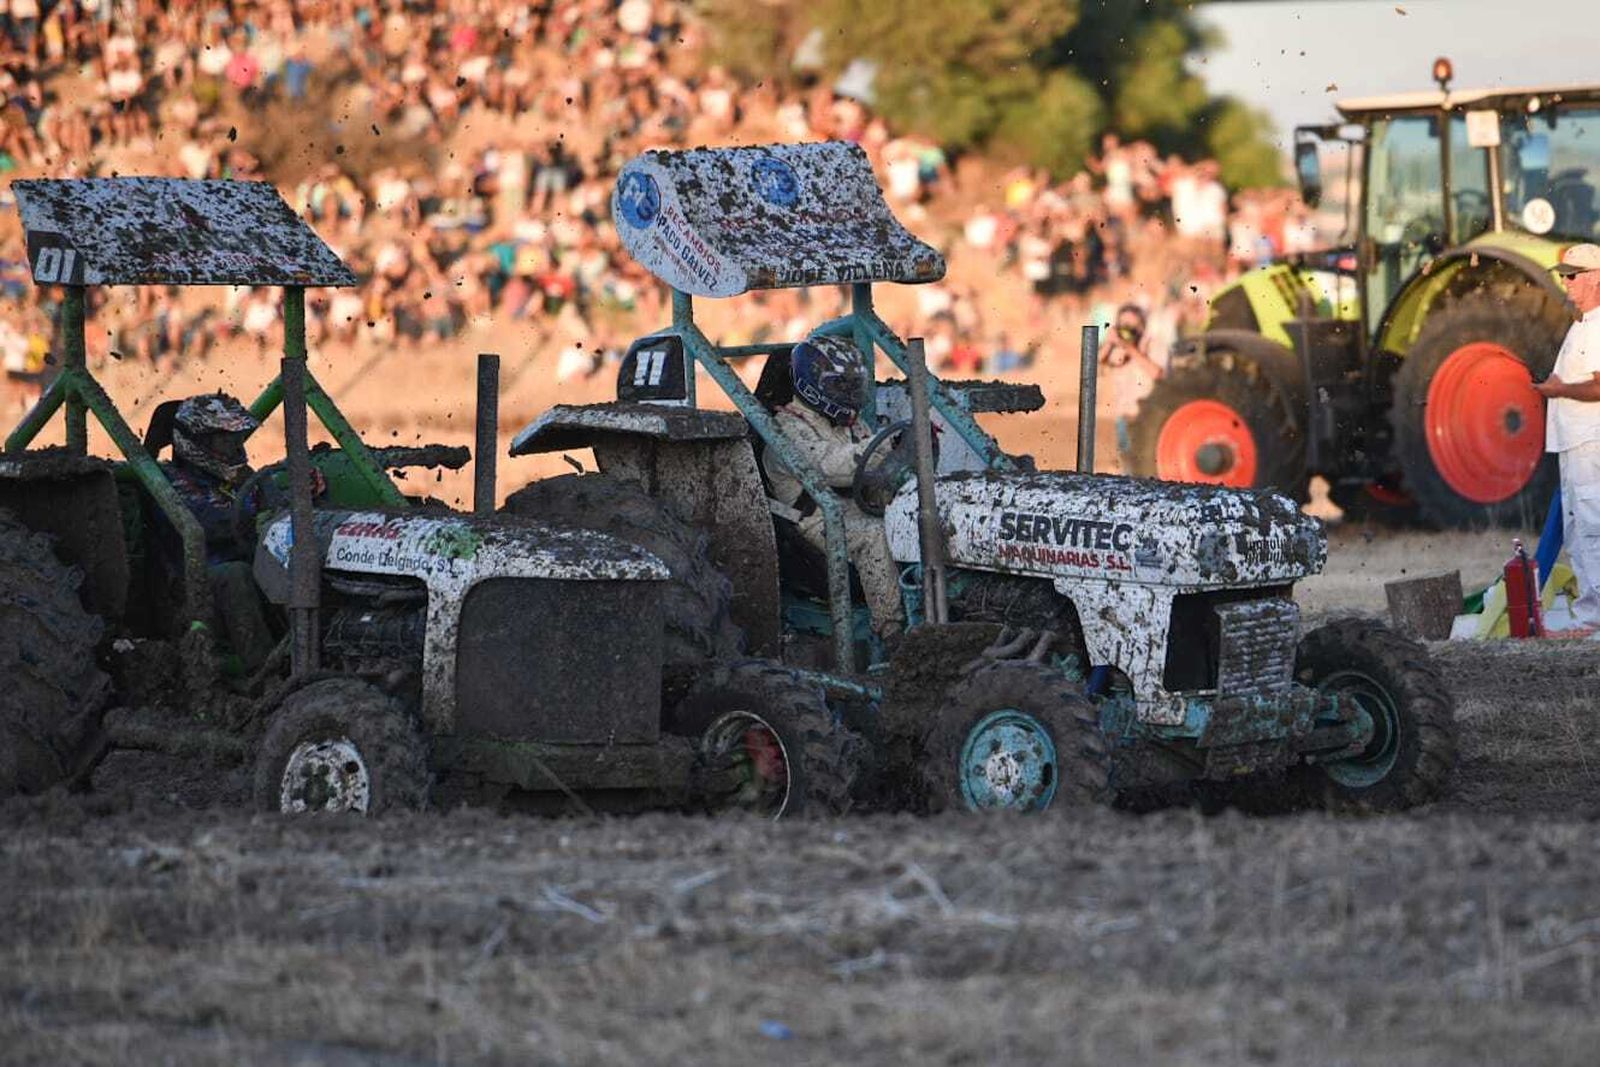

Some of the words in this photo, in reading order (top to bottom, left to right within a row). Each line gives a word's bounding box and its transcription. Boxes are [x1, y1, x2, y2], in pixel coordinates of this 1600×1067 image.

[633, 351, 666, 386] 11
[1000, 512, 1133, 551] SERVITEC
[336, 547, 375, 564] Conde
[998, 544, 1100, 568] MAQUINARIAS
